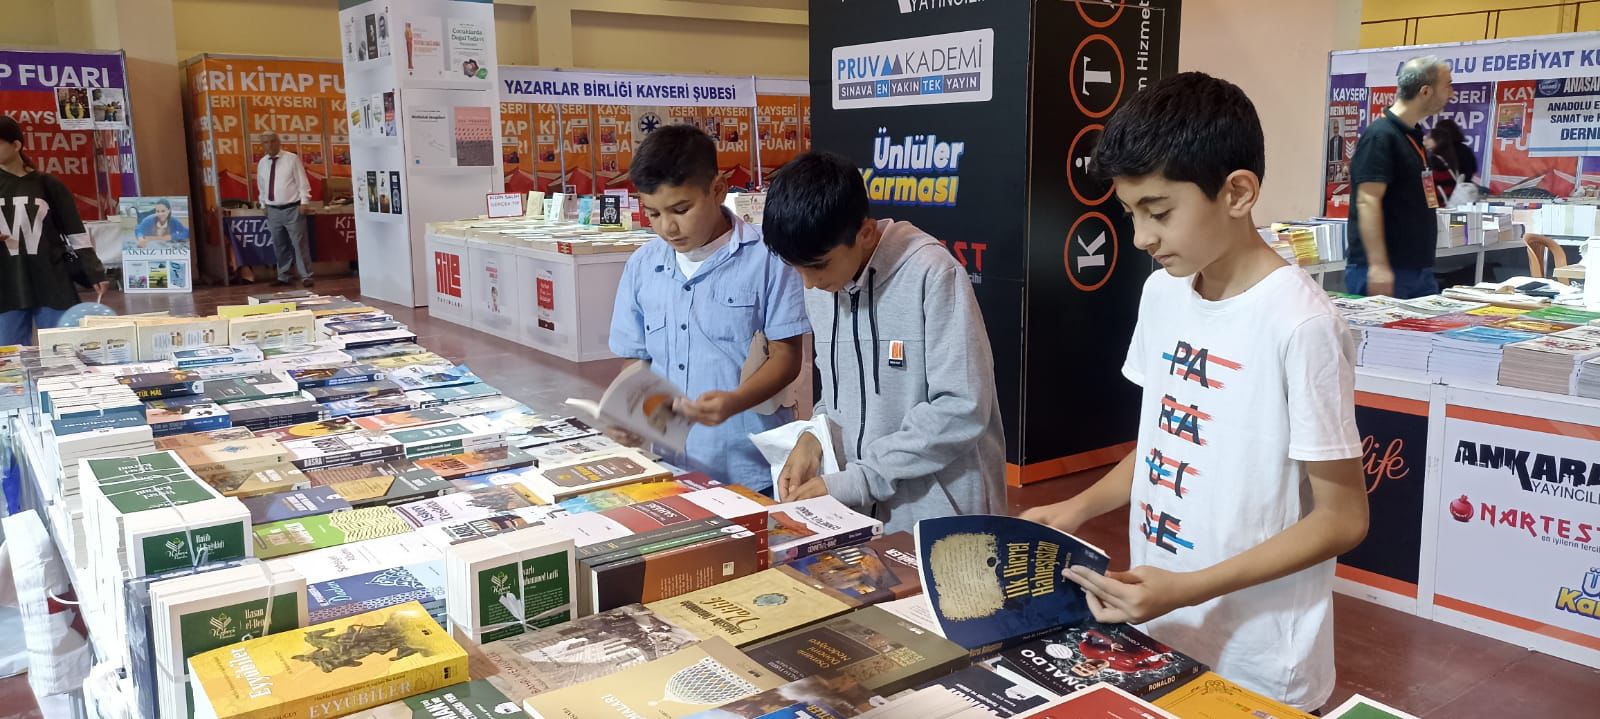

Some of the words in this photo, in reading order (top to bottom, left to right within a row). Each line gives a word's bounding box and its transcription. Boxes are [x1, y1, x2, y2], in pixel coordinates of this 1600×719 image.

[1482, 49, 1574, 72] EDEBİYAT
[19, 64, 110, 88] FUARI
[240, 66, 314, 93] KİTAP
[841, 85, 873, 97] SINAVA
[876, 83, 888, 95] EN
[891, 80, 919, 93] YAKIN
[922, 79, 941, 91] TEK
[946, 76, 977, 89] YAYIN
[504, 80, 579, 96] YAZARLAR
[584, 80, 632, 98] BİRLİĞİ
[637, 83, 689, 99] KAYSERİ
[693, 84, 736, 102] ŞUBESİ
[1548, 101, 1591, 111] ANADOLU
[254, 109, 319, 132] KİTAP
[1551, 114, 1581, 123] SANAT
[873, 126, 965, 171] Ünlüler
[0, 196, 50, 256] W
[1532, 480, 1600, 505] YAYINCIL
[1003, 542, 1030, 578] Hicret
[1029, 540, 1060, 597] Habeşistan
[1148, 675, 1176, 692] RONALDO
